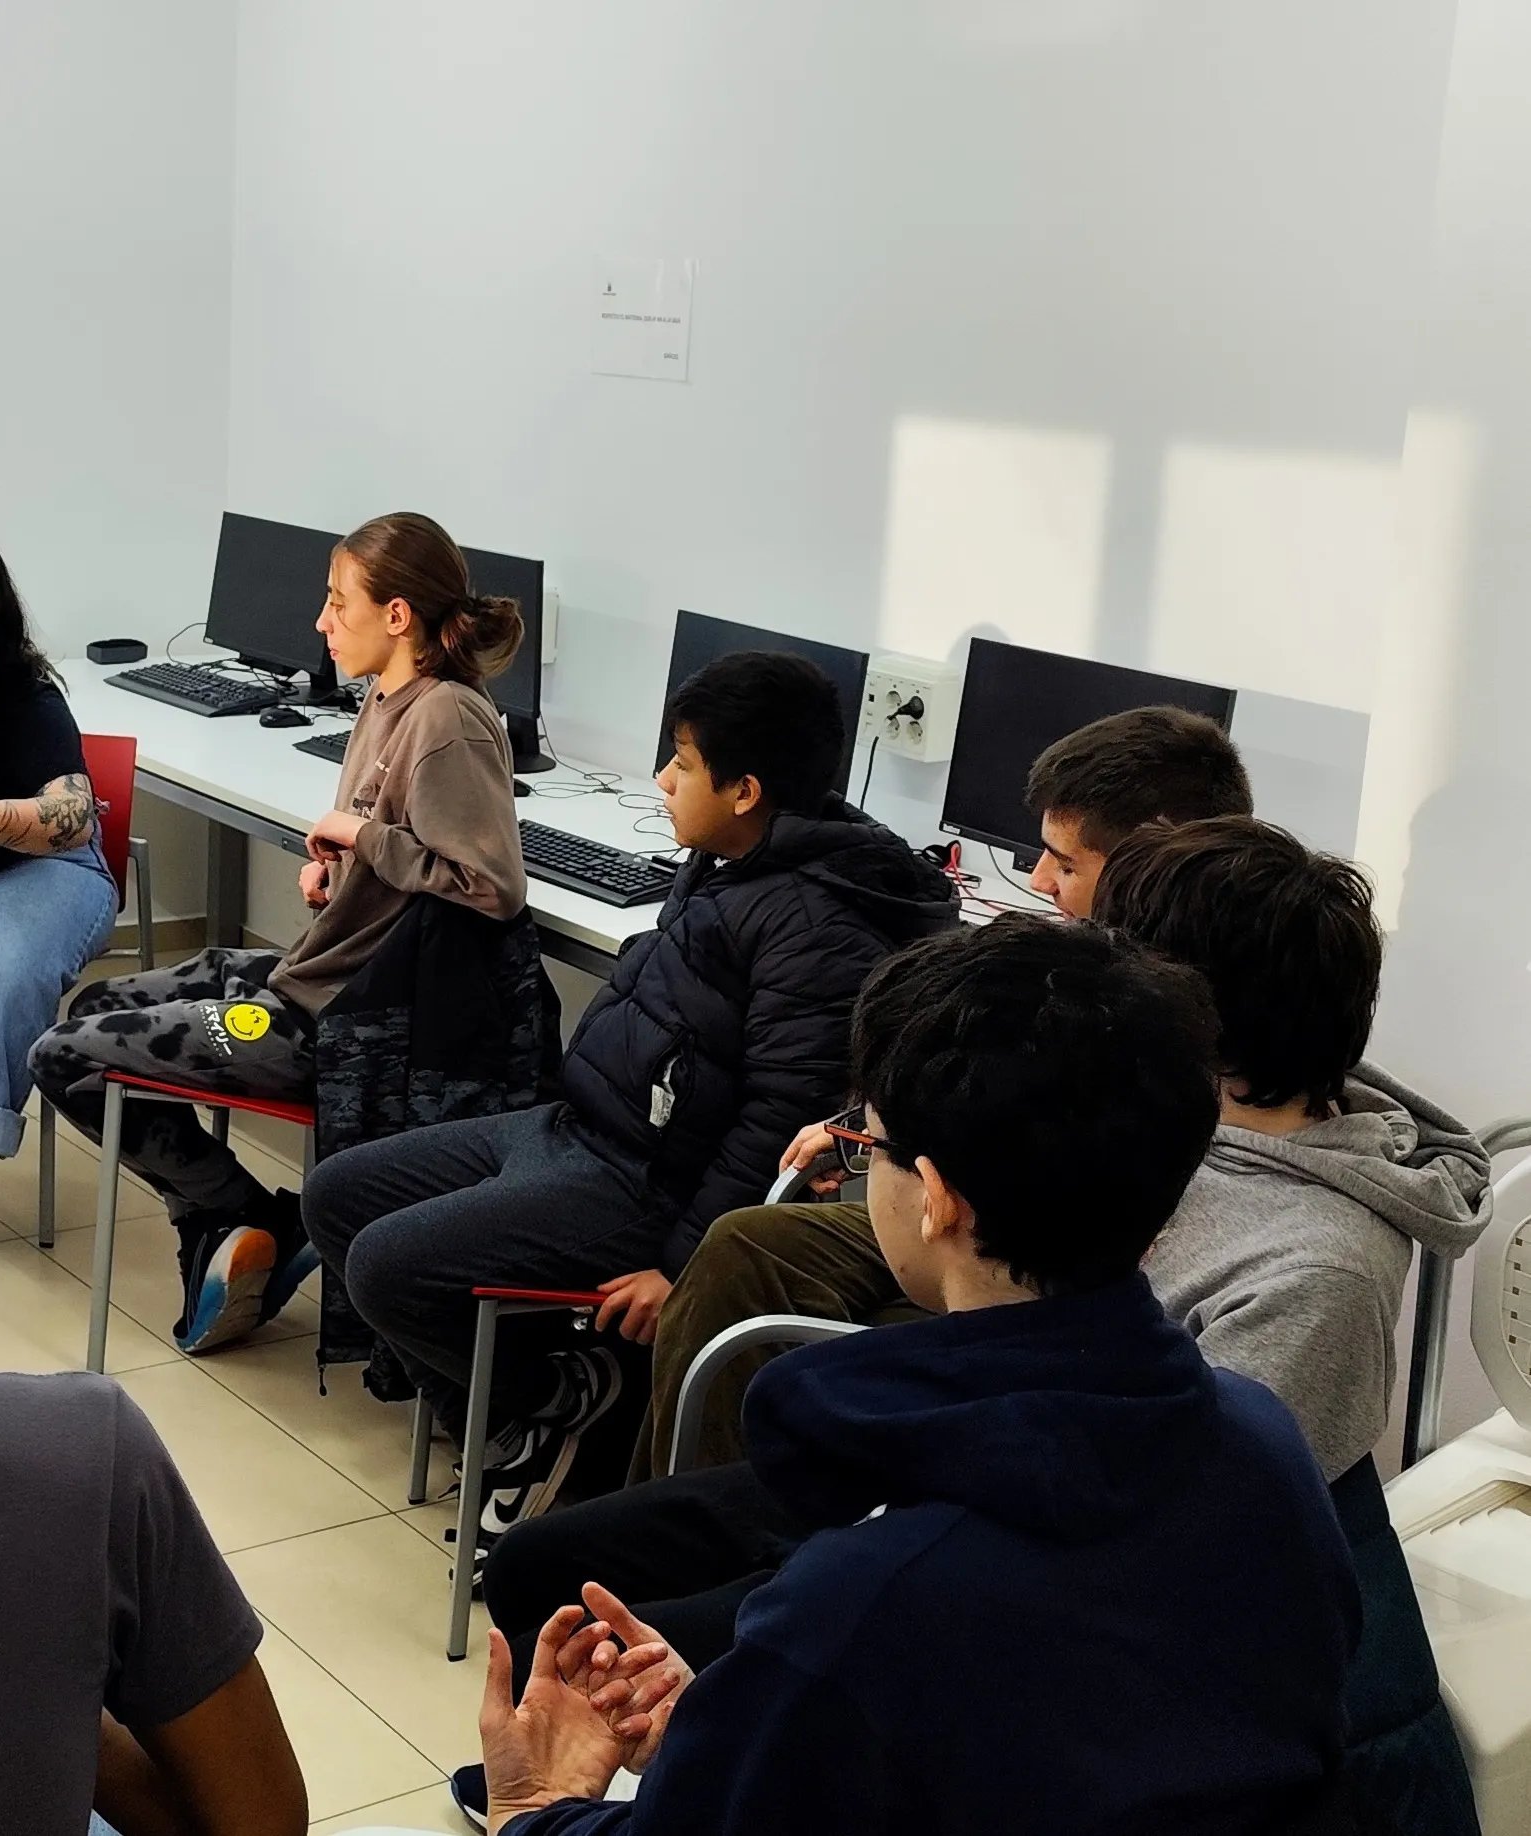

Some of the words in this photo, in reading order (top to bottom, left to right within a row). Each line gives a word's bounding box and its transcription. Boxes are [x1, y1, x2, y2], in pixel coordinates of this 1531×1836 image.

[204, 1004, 233, 1056] スマイリー
